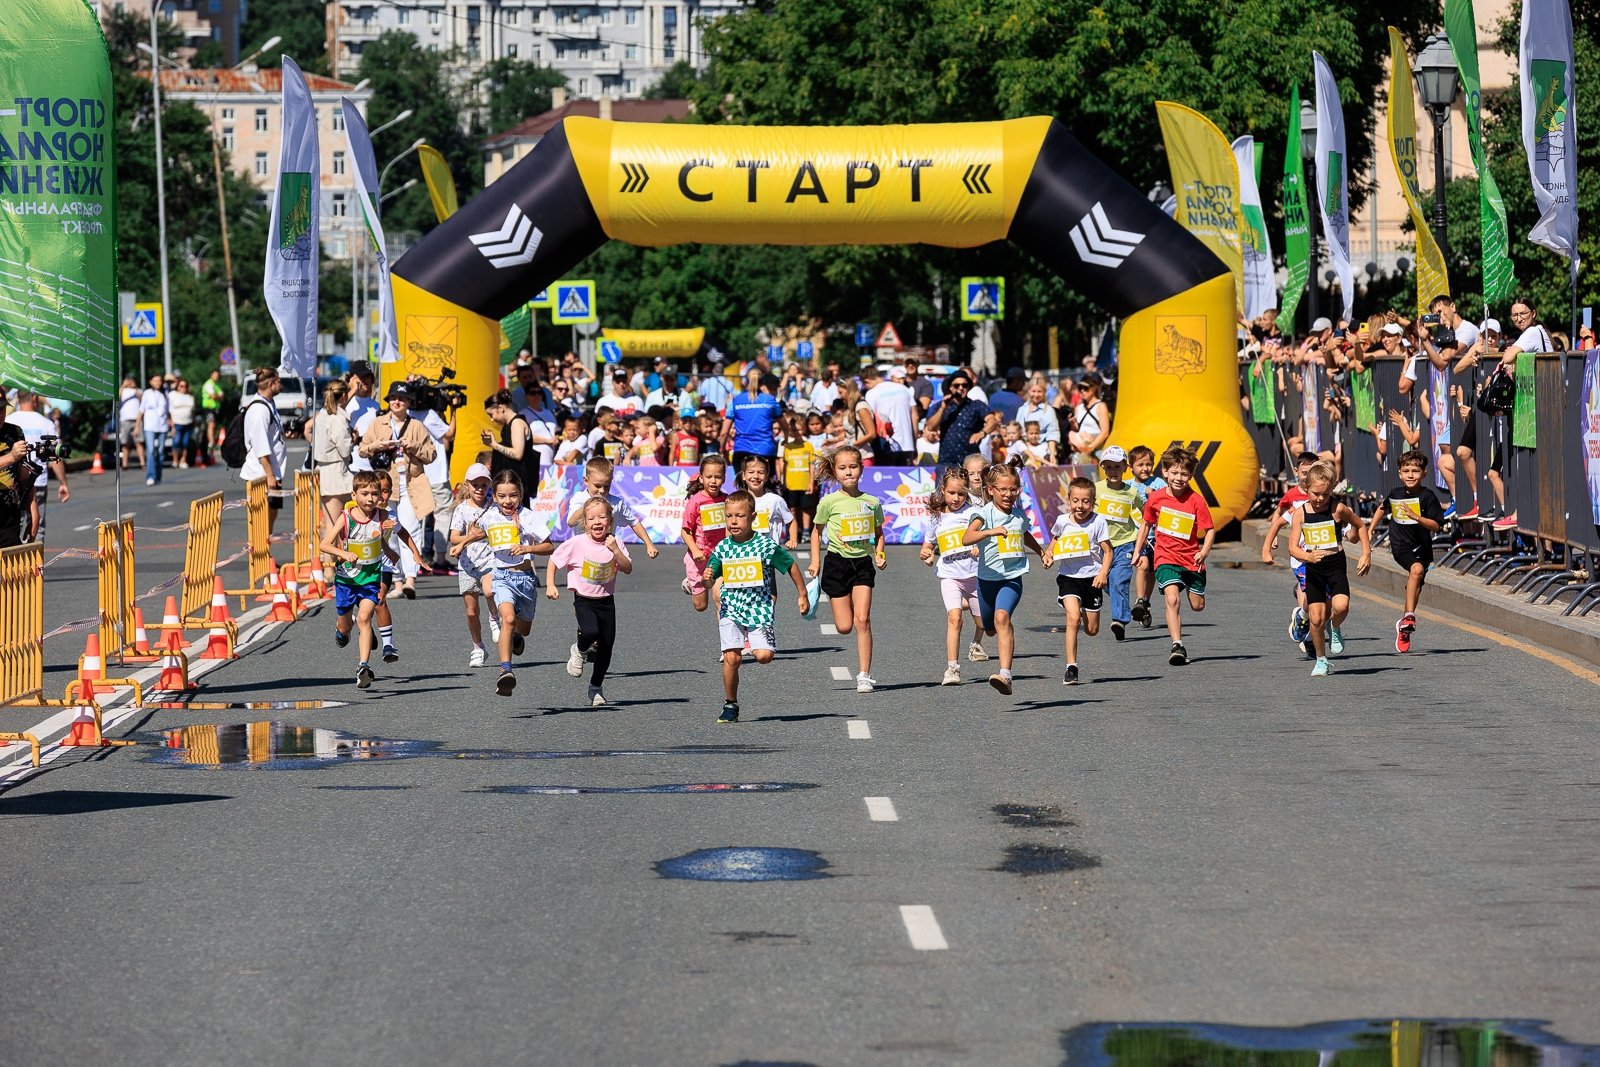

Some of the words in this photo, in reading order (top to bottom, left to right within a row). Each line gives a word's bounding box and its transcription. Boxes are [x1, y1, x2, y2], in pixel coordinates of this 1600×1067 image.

[677, 158, 934, 204] СТАРТ
[659, 497, 687, 507] ЗАБЕ
[1106, 502, 1124, 516] 64
[650, 509, 685, 519] ПЕРВ
[847, 518, 871, 534] 199
[1170, 517, 1181, 530] 5
[490, 528, 512, 545] 135
[1307, 528, 1330, 543] 158
[1058, 535, 1084, 552] 142
[362, 545, 372, 559] 9
[589, 565, 612, 580] 129
[726, 564, 758, 581] 209
